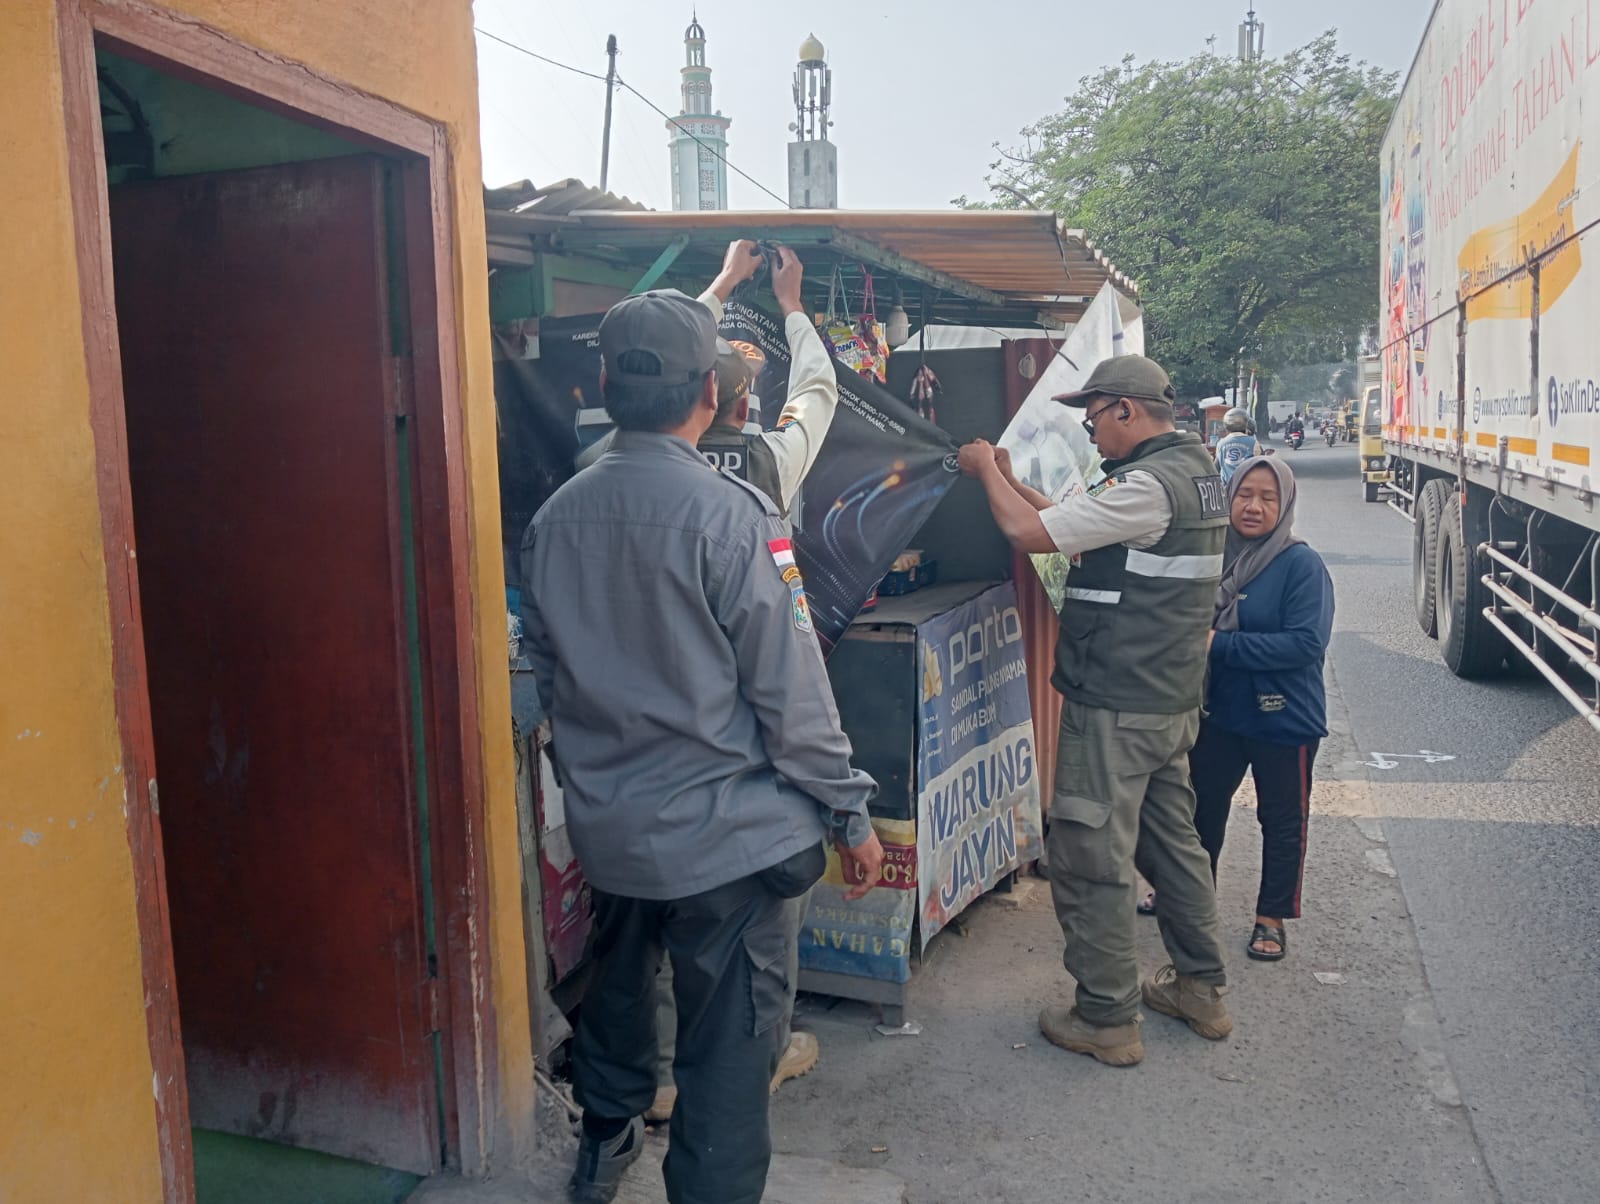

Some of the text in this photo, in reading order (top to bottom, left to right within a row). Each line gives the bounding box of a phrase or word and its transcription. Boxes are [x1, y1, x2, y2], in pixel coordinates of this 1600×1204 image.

[1512, 15, 1575, 150] TAHAN
[949, 605, 1023, 687] porto
[951, 684, 978, 716] SANDAL
[929, 737, 1032, 850] WARUNG
[941, 808, 1016, 908] JAYIN
